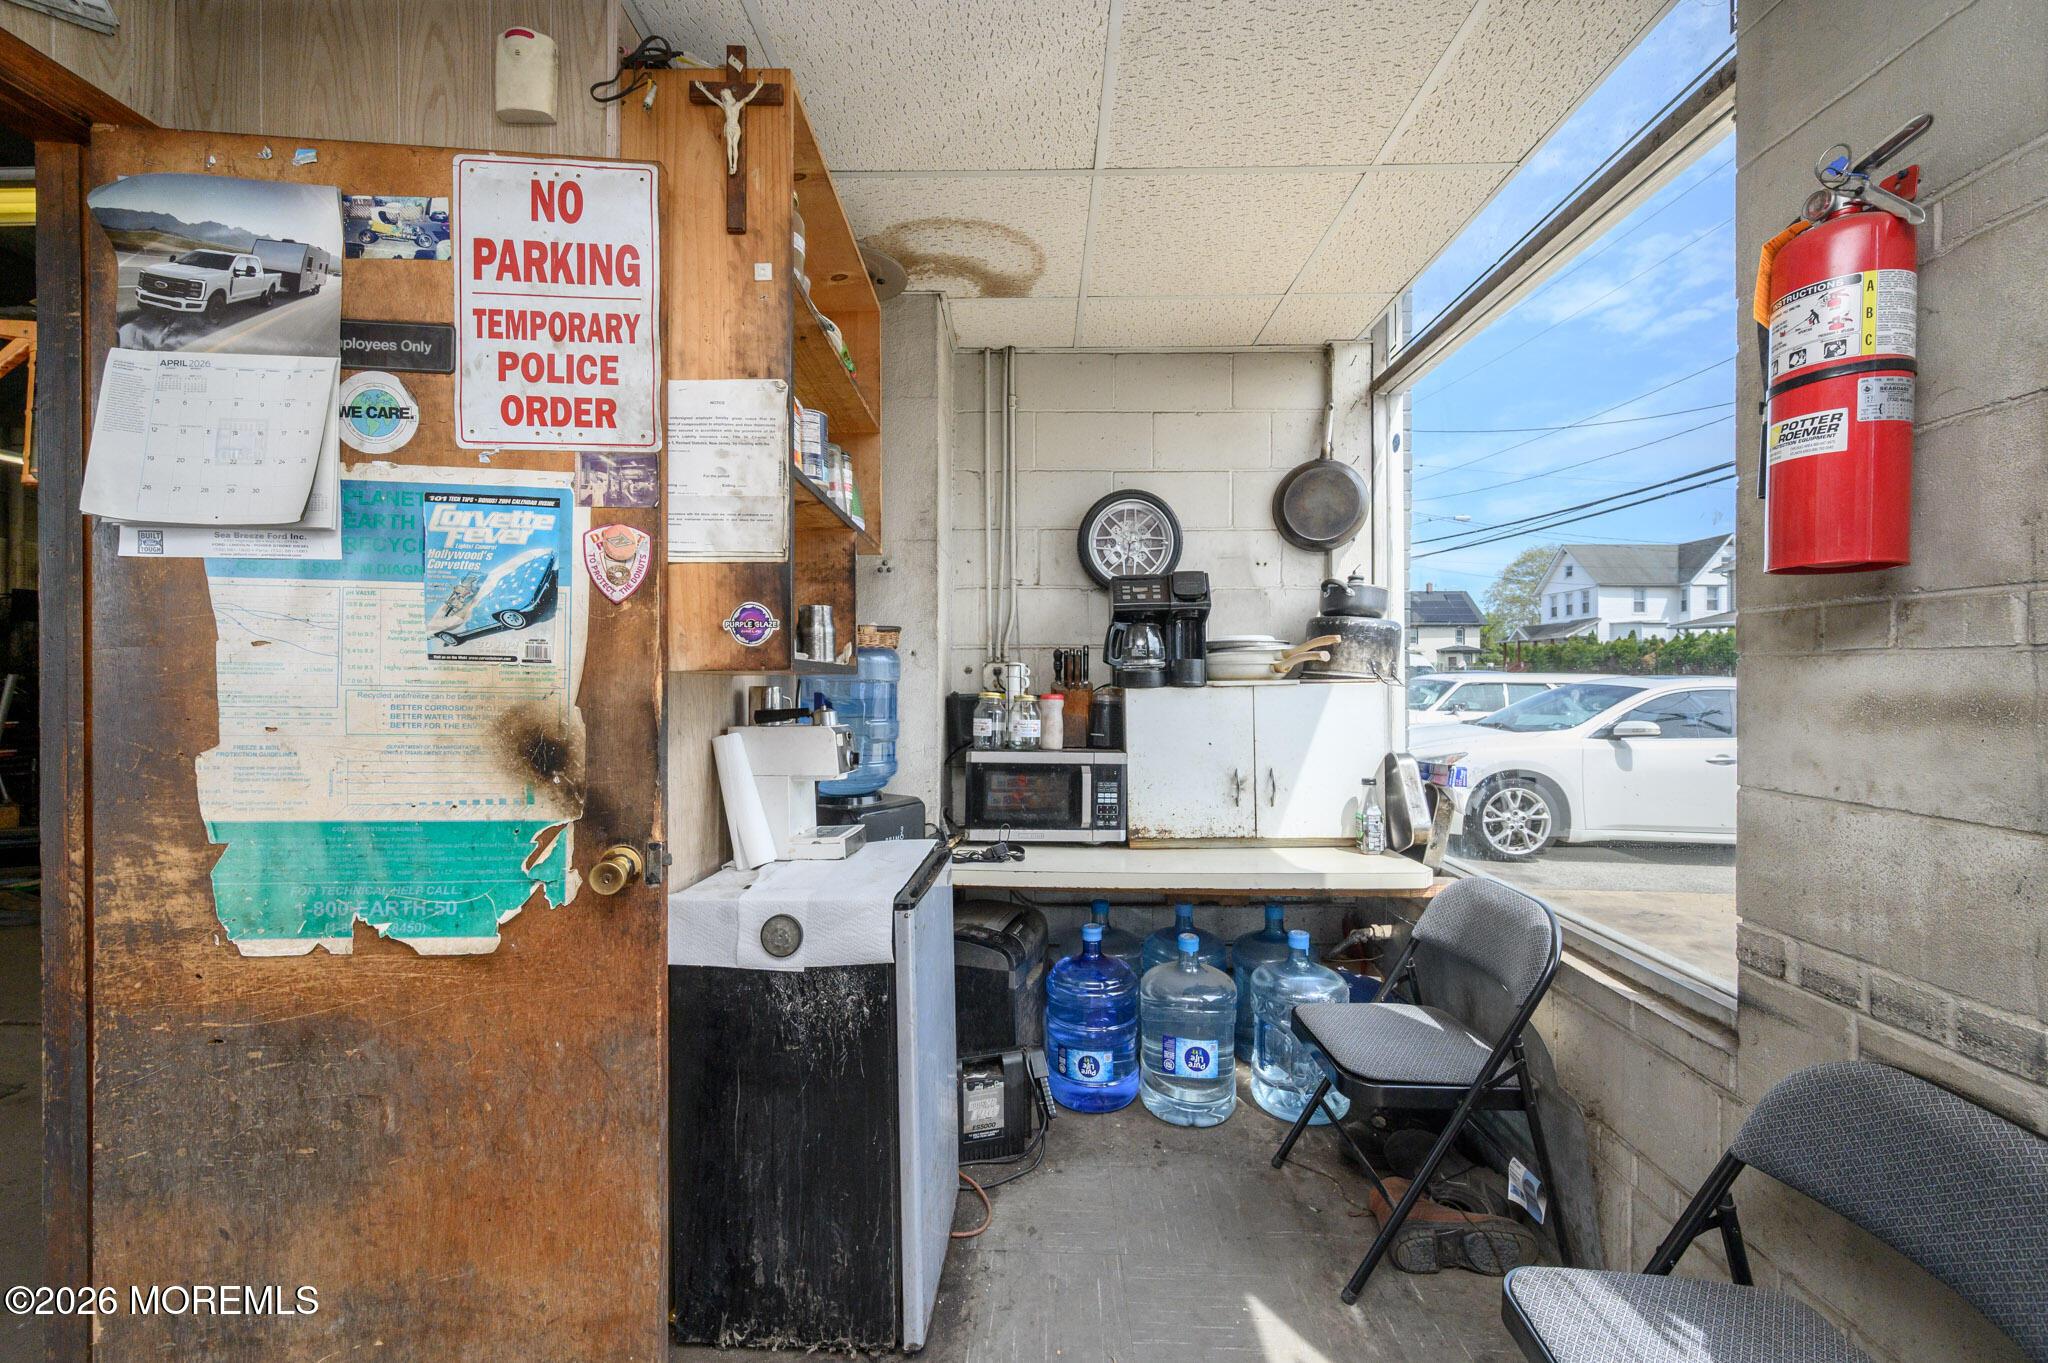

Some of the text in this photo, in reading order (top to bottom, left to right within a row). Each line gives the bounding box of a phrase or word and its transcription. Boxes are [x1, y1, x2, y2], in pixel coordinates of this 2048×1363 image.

[531, 180, 584, 224] NO
[473, 238, 641, 287] PARKING
[1867, 280, 1874, 292] A
[1866, 307, 1873, 319] B
[473, 308, 640, 344] TEMPORARY
[340, 337, 432, 355] ployees Only
[1866, 334, 1872, 346] C
[160, 359, 187, 367] APRIL
[189, 359, 211, 368] 2026
[498, 351, 619, 385] POLICE
[340, 405, 414, 419] WE CARE.
[500, 394, 617, 429] ORDER
[1781, 412, 1843, 433] POTTER
[1778, 423, 1840, 443] ROEMER
[343, 512, 415, 529] EARTH
[429, 504, 556, 532] Corvette
[444, 527, 534, 549] Fever
[427, 548, 494, 561] Hollywood's
[427, 560, 481, 571] Corvettes
[632, 554, 647, 584] DONUTS
[592, 564, 617, 596] PROTECT
[619, 584, 634, 596] THE
[424, 704, 473, 712] CORROSION
[320, 886, 387, 895] TECHNICAL
[391, 886, 423, 895] HELP
[426, 886, 463, 895] CALL:
[1189, 1054, 1204, 1063] Life
[1080, 1068, 1097, 1076] Pure
[1082, 1062, 1095, 1070] Life
[1187, 1062, 1206, 1070] Pure
